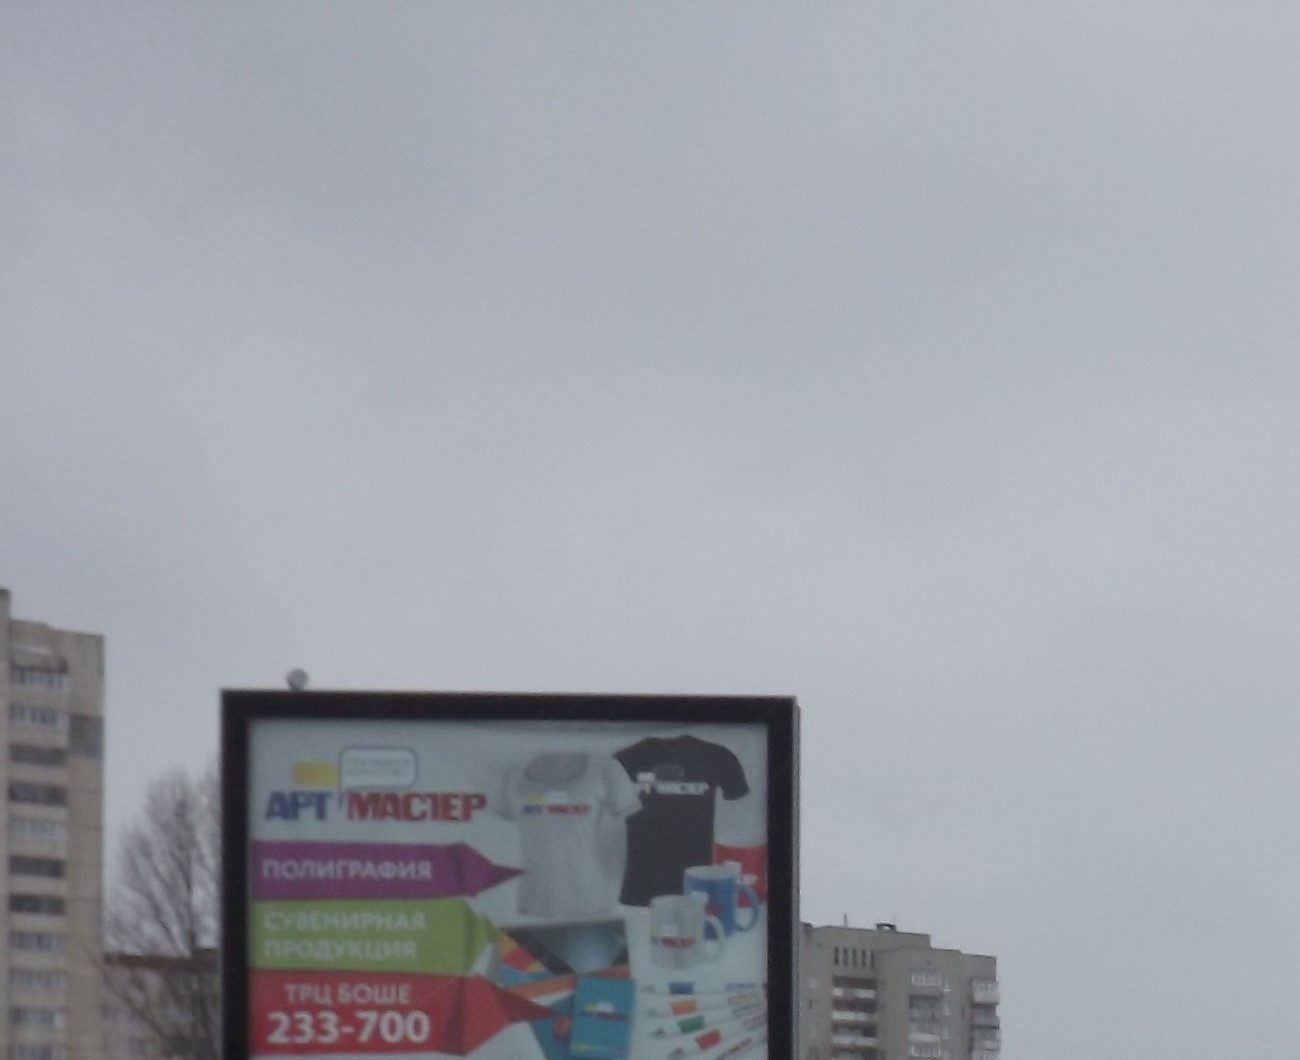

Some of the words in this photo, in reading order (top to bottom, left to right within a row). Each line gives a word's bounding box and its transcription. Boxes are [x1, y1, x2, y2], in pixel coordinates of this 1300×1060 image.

[265, 791, 333, 822] АРТ
[347, 792, 487, 822] МАСТЕР
[261, 859, 432, 881] ПОЛИГРАФИЯ
[262, 912, 427, 932] СУВЕНИРНАЯ
[263, 940, 417, 961] ПРОДУКЦИЯ
[285, 983, 334, 1007] ТРЦ
[338, 983, 411, 1005] БОШЕ
[267, 1011, 430, 1044] 233-700
